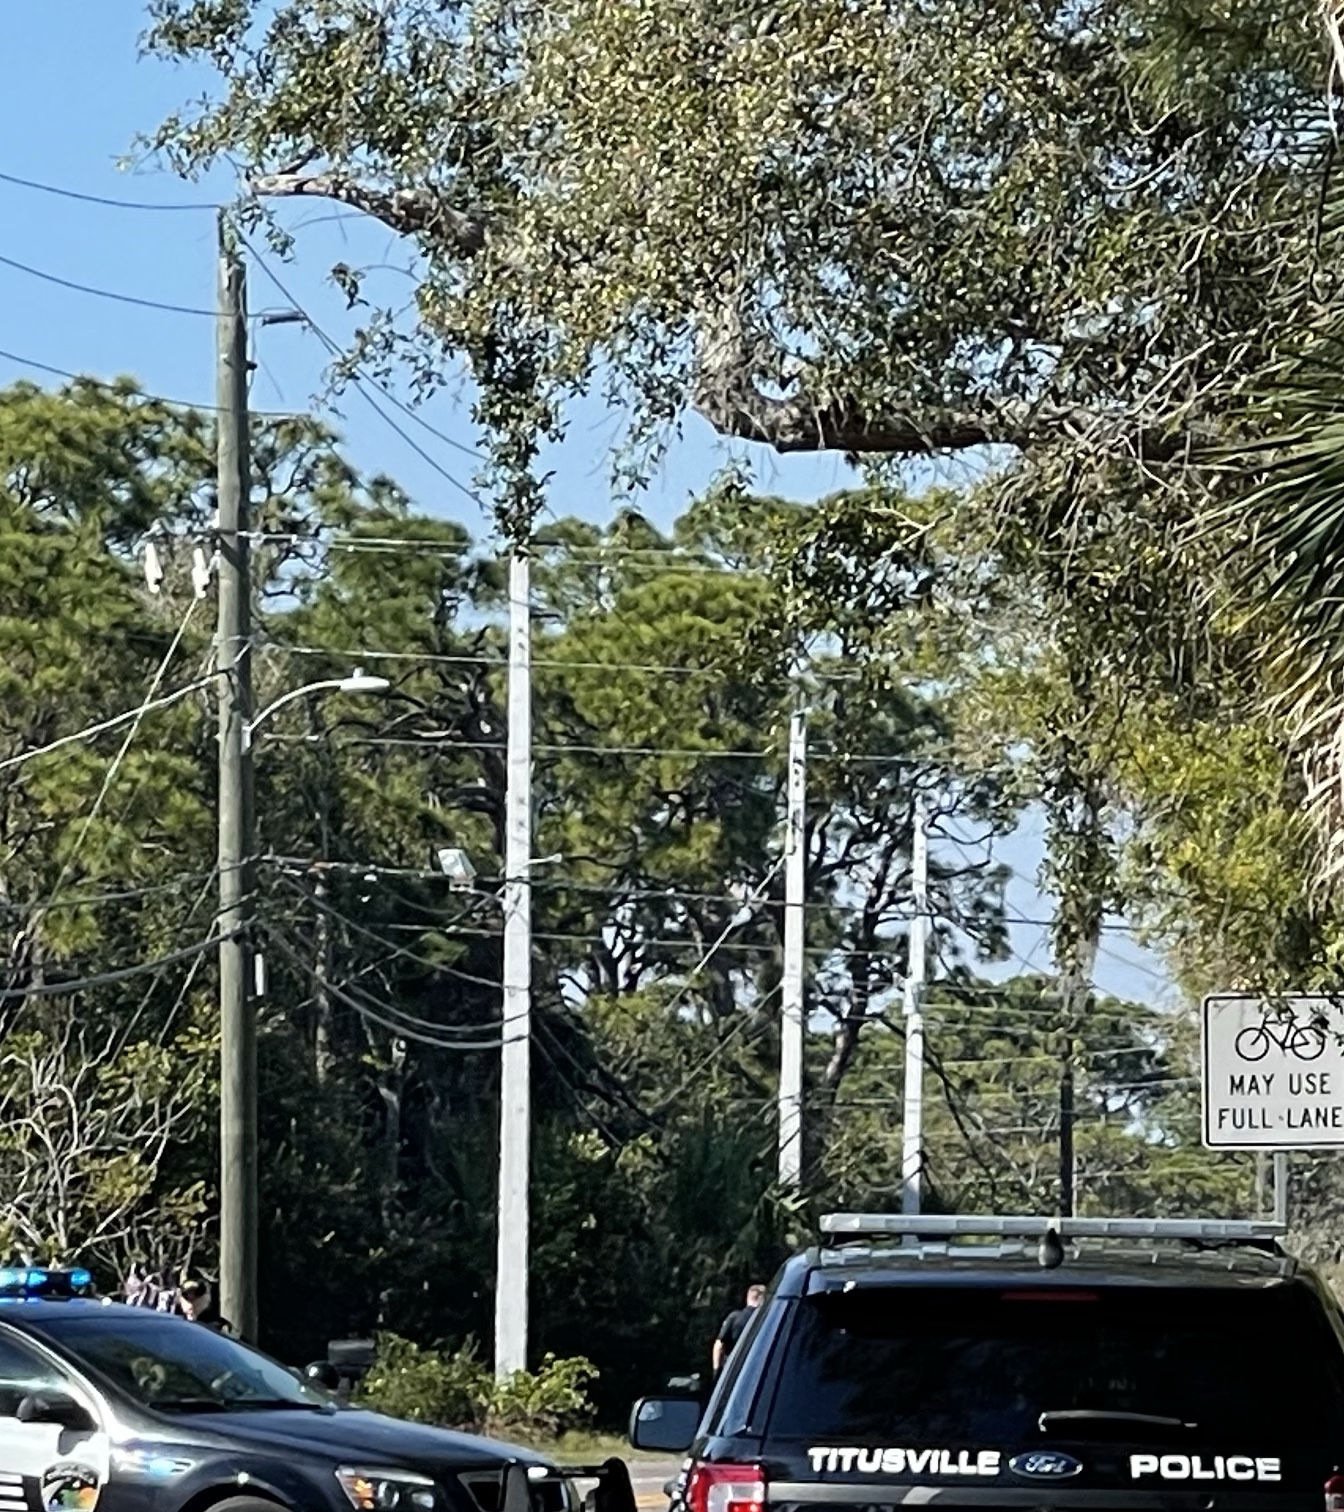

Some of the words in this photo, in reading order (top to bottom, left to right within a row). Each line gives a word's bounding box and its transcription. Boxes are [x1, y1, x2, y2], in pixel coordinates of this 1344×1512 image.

[1229, 1073, 1275, 1096] MAY
[1289, 1072, 1332, 1096] USE
[1217, 1107, 1274, 1130] FULL
[1287, 1106, 1344, 1129] LANE
[808, 1447, 1001, 1476] TITUSVILLE
[1130, 1454, 1282, 1481] POLICE
